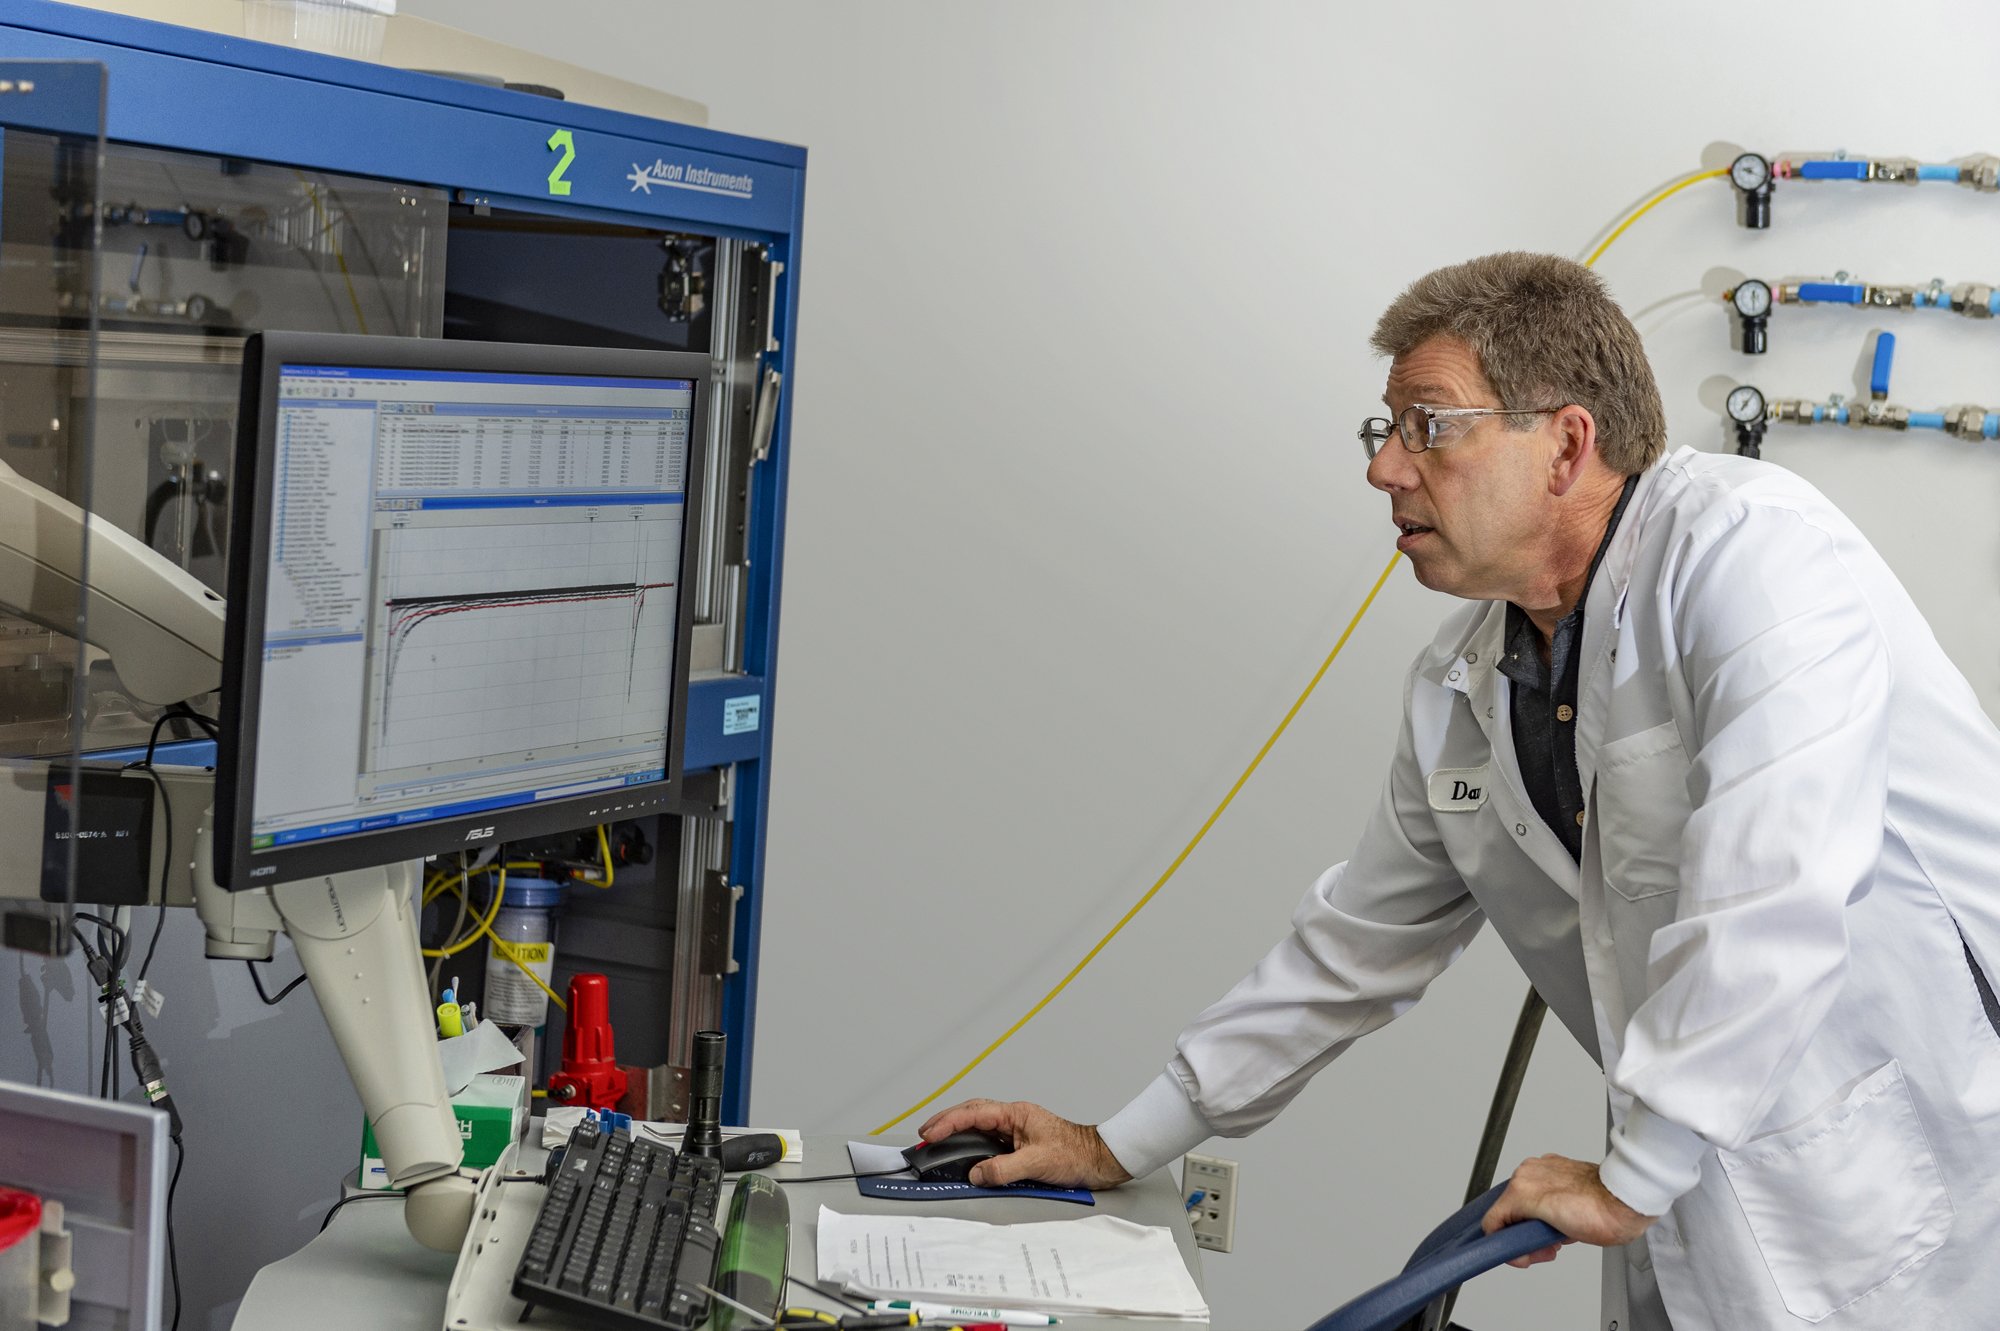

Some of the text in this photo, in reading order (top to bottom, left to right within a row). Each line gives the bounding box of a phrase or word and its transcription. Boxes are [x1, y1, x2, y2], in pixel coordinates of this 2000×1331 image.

[547, 128, 576, 196] 2
[652, 158, 754, 193] Axon Instruments
[465, 826, 496, 841] ASUS
[495, 946, 545, 961] CUTION
